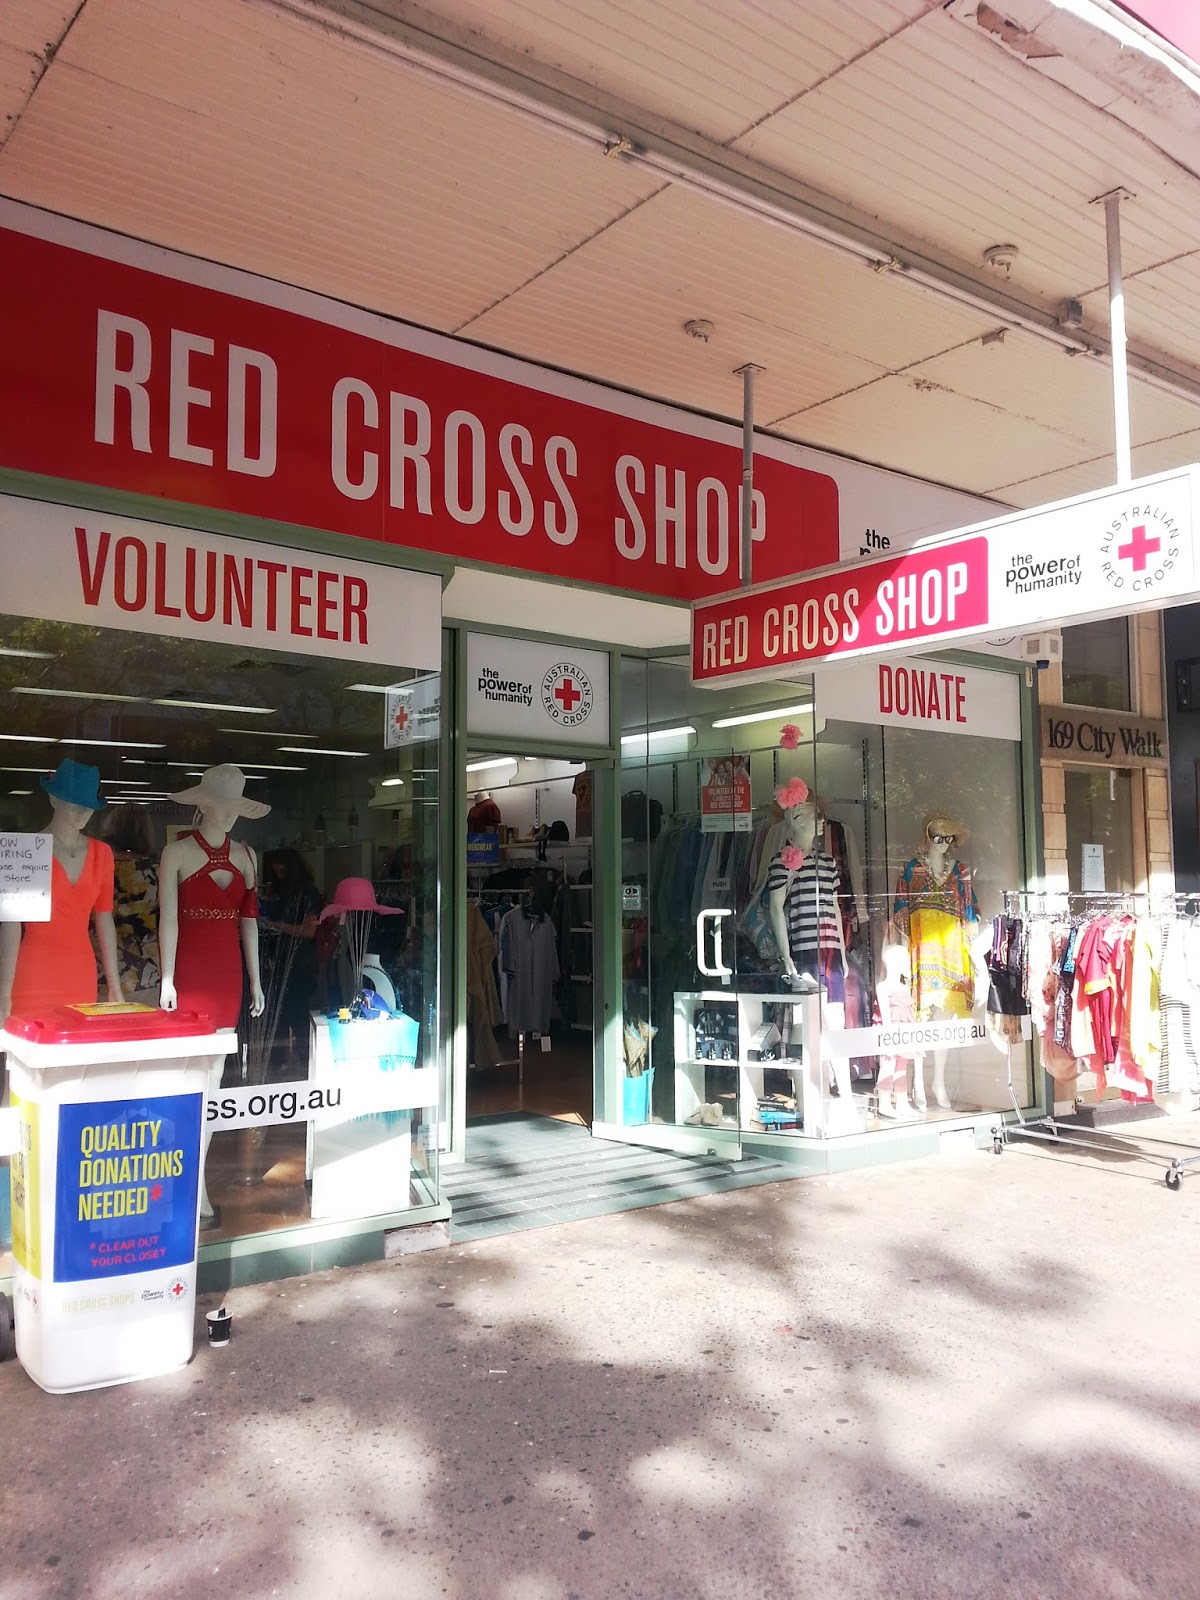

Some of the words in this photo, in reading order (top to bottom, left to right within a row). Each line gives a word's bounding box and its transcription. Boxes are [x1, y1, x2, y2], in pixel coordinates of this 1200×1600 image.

[94, 308, 278, 478] RED
[331, 376, 579, 546] CROSS
[614, 454, 767, 580] SHOP
[865, 528, 890, 549] the
[1100, 505, 1180, 553] AUSTRALIAN
[1011, 554, 1033, 567] the
[1101, 561, 1124, 588] RED
[1132, 548, 1179, 591] CROSS
[74, 527, 369, 645] VOLUNTEER
[1015, 570, 1082, 594] humanity
[702, 615, 749, 670] RED
[762, 587, 859, 658] CROSS
[876, 561, 968, 636] SHOP
[482, 667, 499, 679] the
[544, 665, 591, 696] AUSTRALIAN
[485, 688, 533, 706] humanity
[879, 664, 967, 723] DONATE
[544, 696, 559, 718] RED
[563, 701, 591, 724] CROSS
[1048, 718, 1074, 749] 169
[1077, 723, 1116, 759] City
[1118, 727, 1163, 758] Walk
[0, 838, 18, 847] OW
[0, 849, 32, 859] IRING
[5, 874, 31, 882] store
[22, 864, 49, 874] enquire
[878, 1025, 986, 1047] redcross.org.au
[207, 1088, 341, 1122] ss.org.au
[81, 1120, 162, 1158] QUALITY
[79, 1149, 184, 1188] DONATIONS
[98, 1239, 136, 1253] CLEAR
[138, 1235, 159, 1248] OUT
[91, 1255, 122, 1268] YOUR
[124, 1247, 166, 1263] CLOSET
